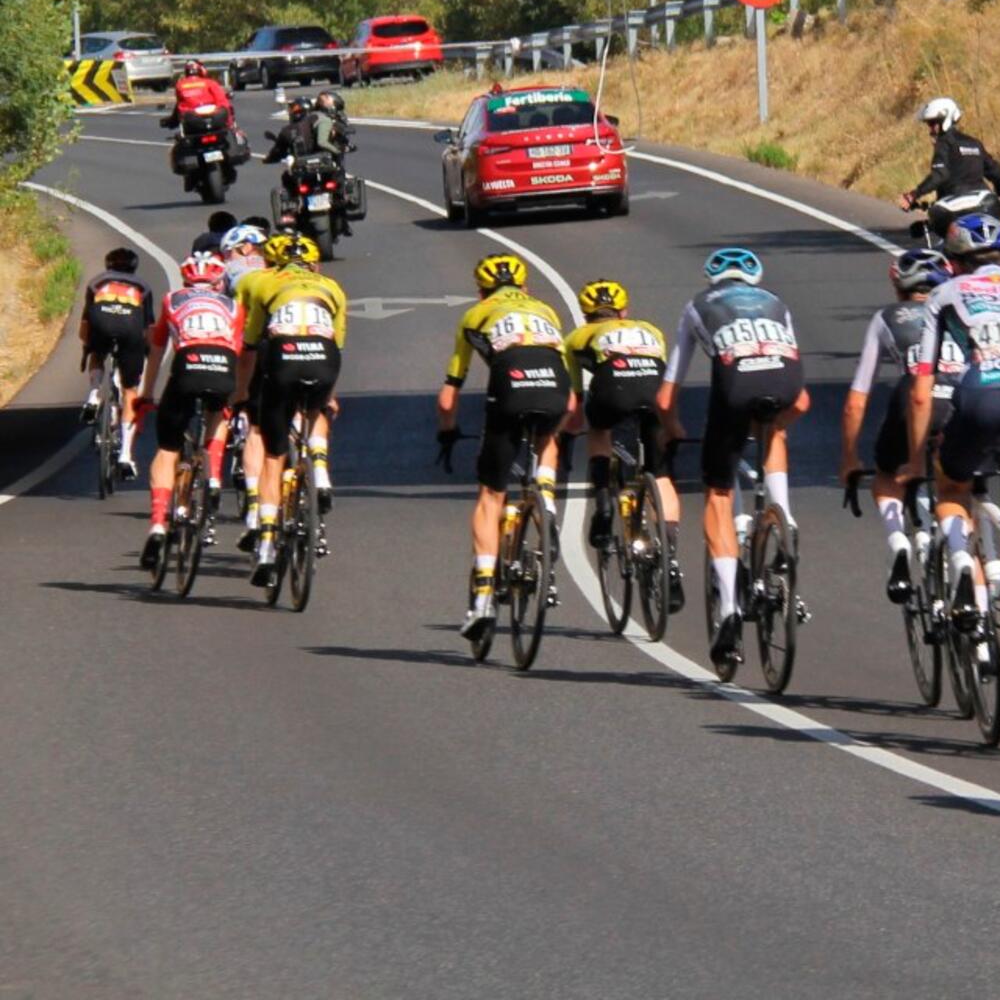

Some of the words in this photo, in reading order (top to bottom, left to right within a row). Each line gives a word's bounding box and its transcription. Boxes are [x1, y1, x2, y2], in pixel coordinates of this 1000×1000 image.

[959, 282, 997, 294] Red
[276, 303, 294, 324] 15
[495, 316, 514, 337] 16
[532, 318, 555, 336] 16
[718, 323, 752, 347] 115
